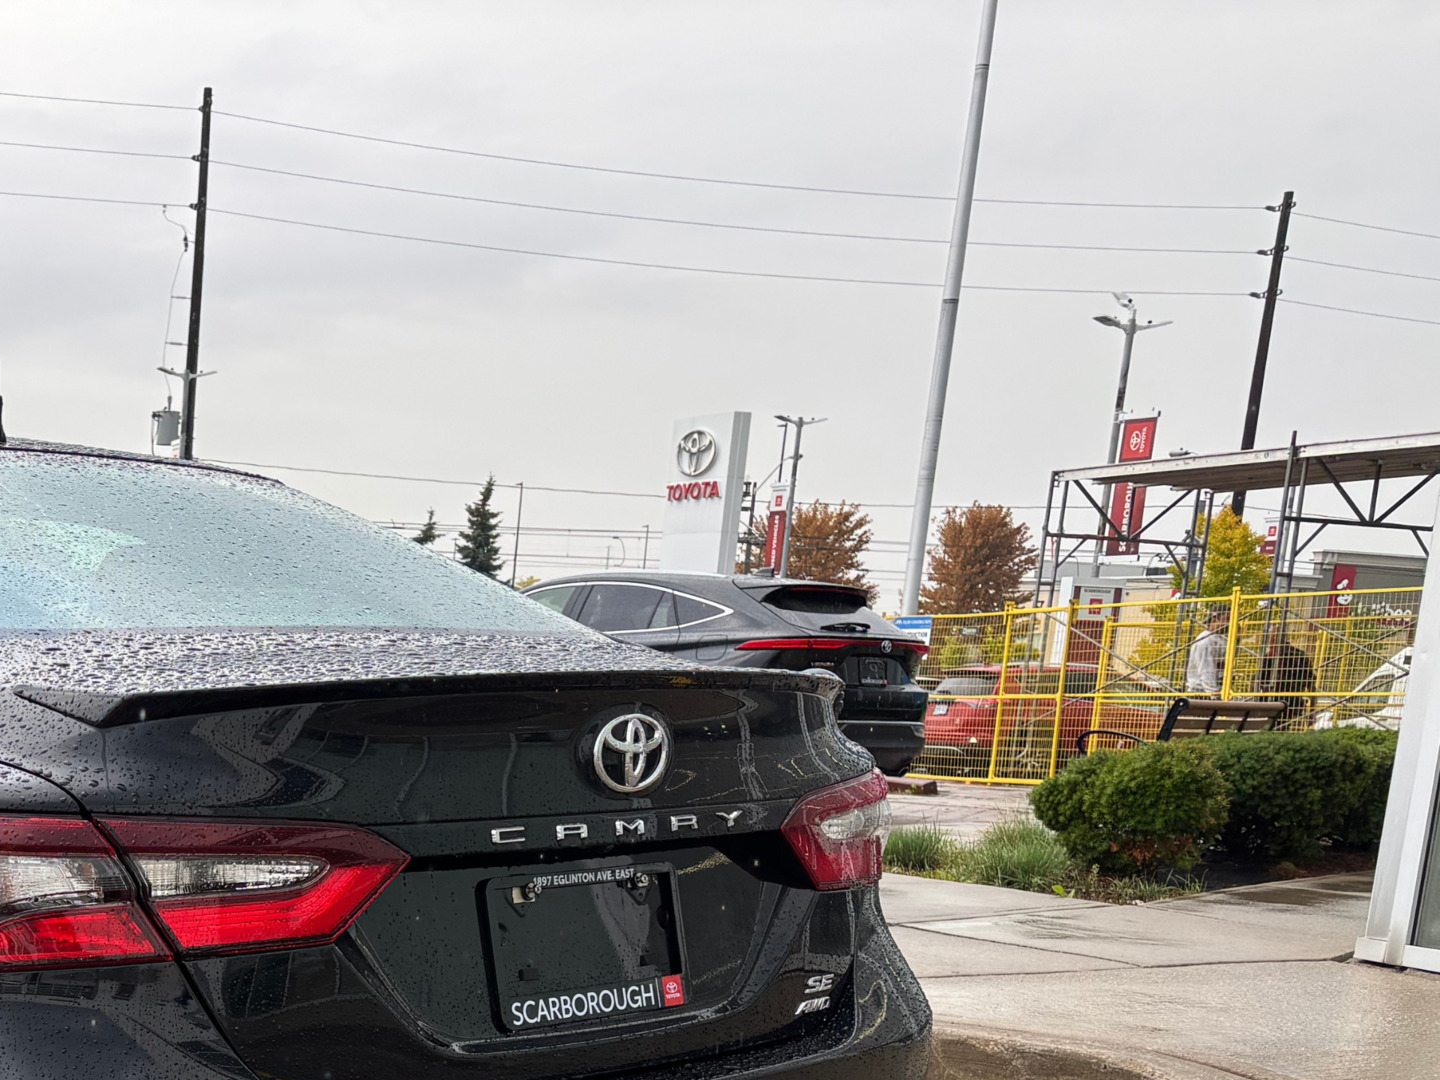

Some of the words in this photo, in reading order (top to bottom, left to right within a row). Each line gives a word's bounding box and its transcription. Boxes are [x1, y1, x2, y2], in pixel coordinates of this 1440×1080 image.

[1139, 427, 1148, 453] TOYOTA
[666, 481, 721, 501] TOYOTA
[490, 809, 743, 844] CAMRY
[532, 876, 552, 887] 1897
[553, 872, 596, 886] EGLINTON
[596, 870, 615, 882] AVE.
[615, 868, 635, 879] EAST
[804, 973, 835, 994] SE
[511, 983, 656, 1026] SCARBOROUGH
[794, 996, 831, 1015] AWD
